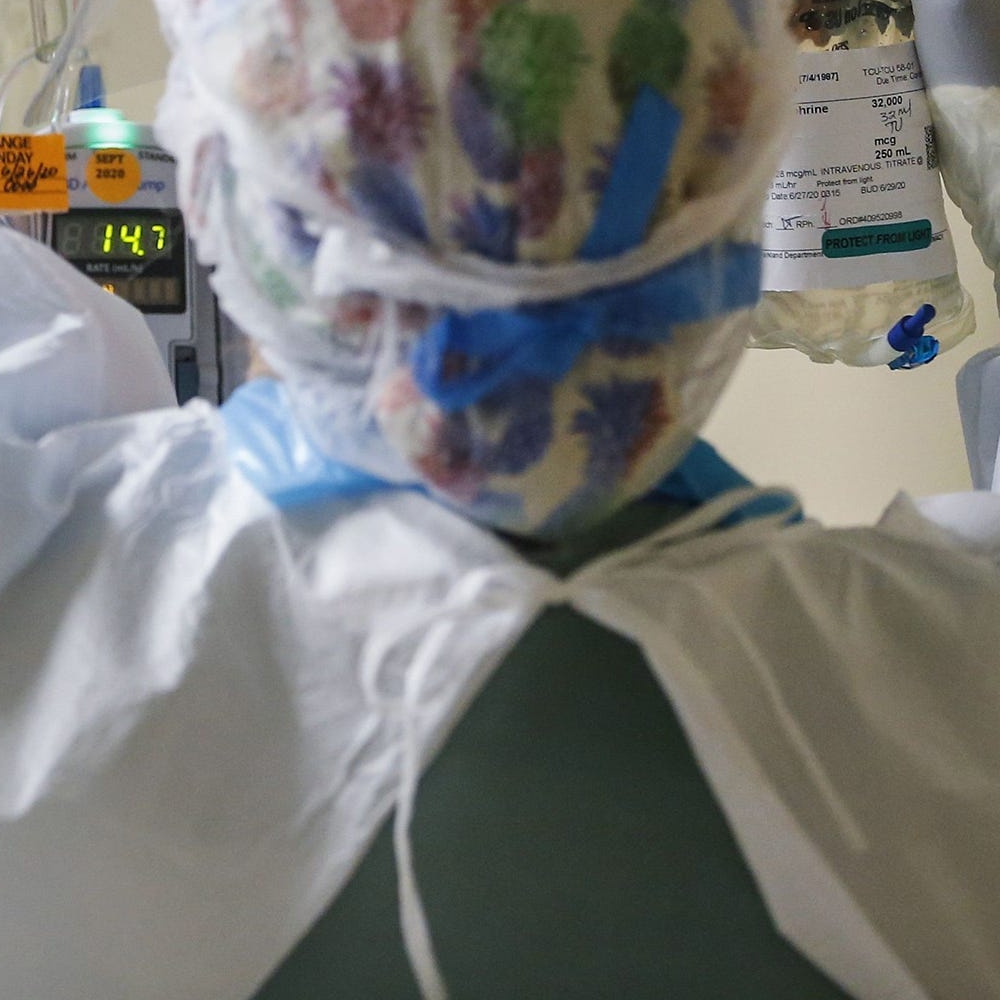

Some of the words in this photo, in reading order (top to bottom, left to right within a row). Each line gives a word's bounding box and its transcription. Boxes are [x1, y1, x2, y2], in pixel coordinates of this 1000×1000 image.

[798, 104, 829, 115] hrine
[870, 95, 903, 108] 32,000
[874, 136, 897, 146] mcg
[96, 153, 124, 164] SEPT
[875, 148, 893, 160] 250
[895, 145, 911, 157] mL
[96, 168, 125, 179] 2020
[820, 162, 882, 175] INTRAVENOUS
[886, 157, 916, 168] TITRATE
[816, 179, 841, 187] Protect
[103, 224, 165, 256] 14.7
[825, 235, 874, 250] PROTECT
[876, 231, 906, 245] FROM
